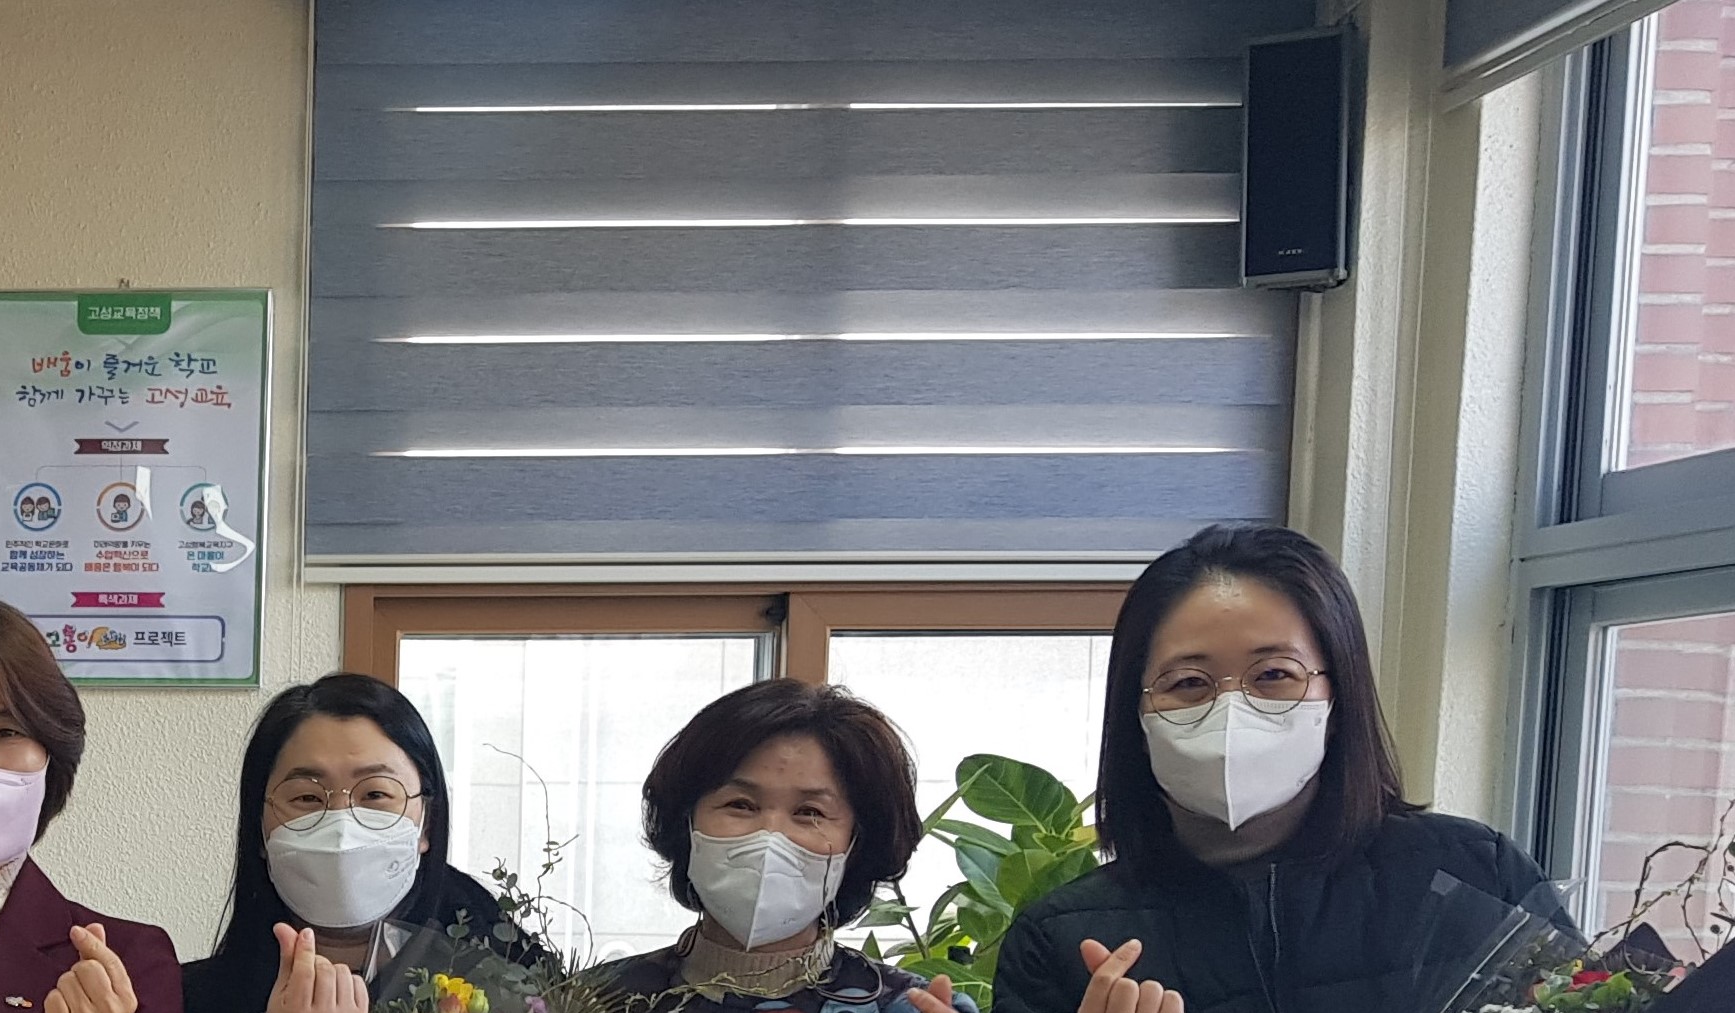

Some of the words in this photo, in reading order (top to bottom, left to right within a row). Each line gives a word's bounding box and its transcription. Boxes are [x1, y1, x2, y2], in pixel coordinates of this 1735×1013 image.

[88, 306, 162, 321] 고성교육정책
[31, 350, 93, 378] 배움이
[102, 352, 163, 381] 즐거운
[168, 351, 218, 379] 학교
[15, 384, 65, 408] 함께
[74, 385, 131, 406] 가꾸는
[144, 384, 233, 409] 고성교육
[133, 631, 187, 648] 프로젝트
